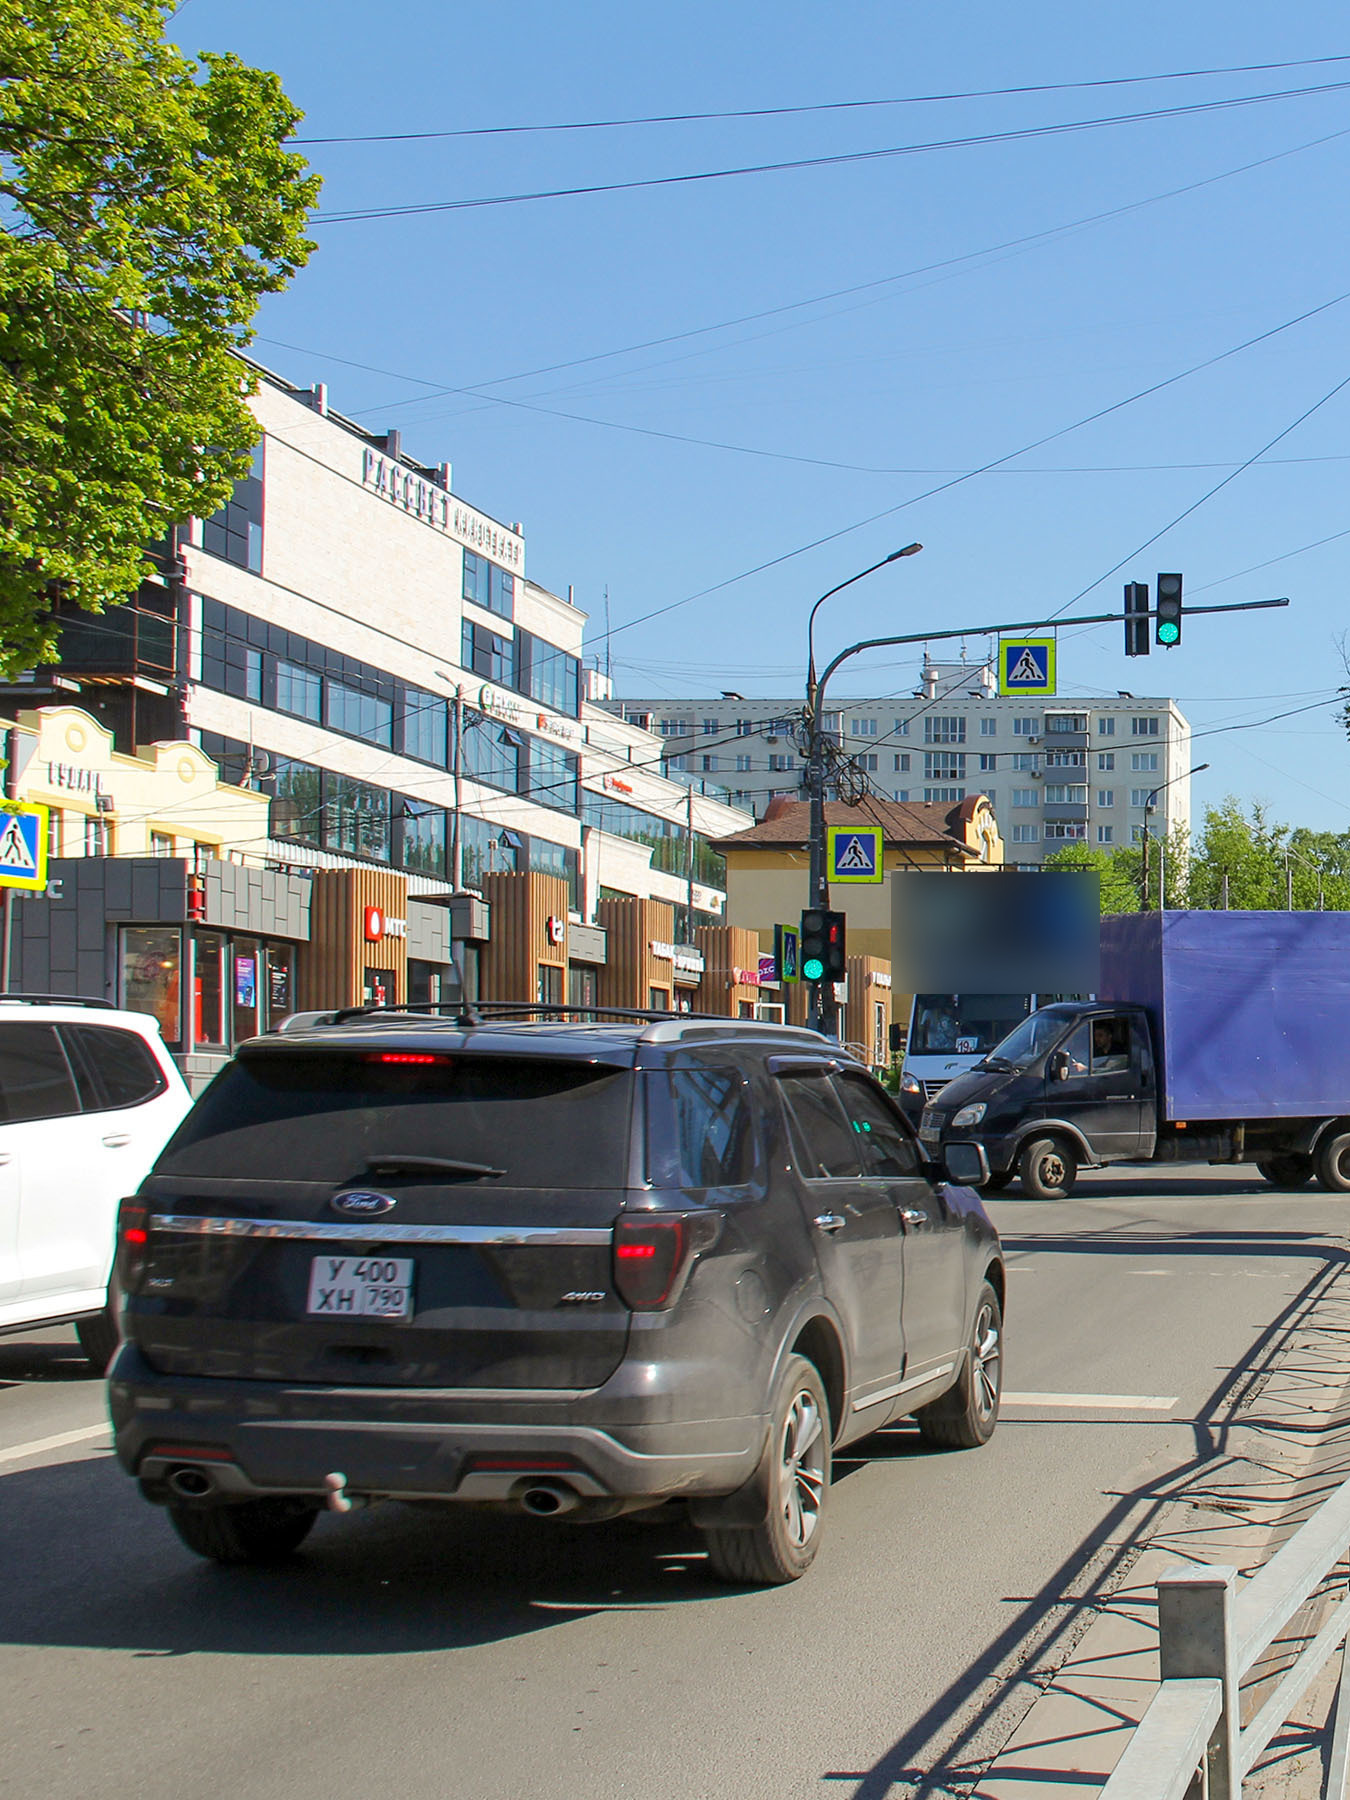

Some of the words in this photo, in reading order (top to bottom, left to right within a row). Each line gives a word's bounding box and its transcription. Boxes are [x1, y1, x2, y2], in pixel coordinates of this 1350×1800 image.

[363, 447, 451, 532] РАССВЕТ
[384, 916, 408, 938] МТС
[343, 1193, 381, 1211] Ford
[328, 1259, 345, 1281] У
[353, 1260, 398, 1283] 400
[317, 1287, 356, 1312] ХН
[368, 1288, 405, 1306] 790
